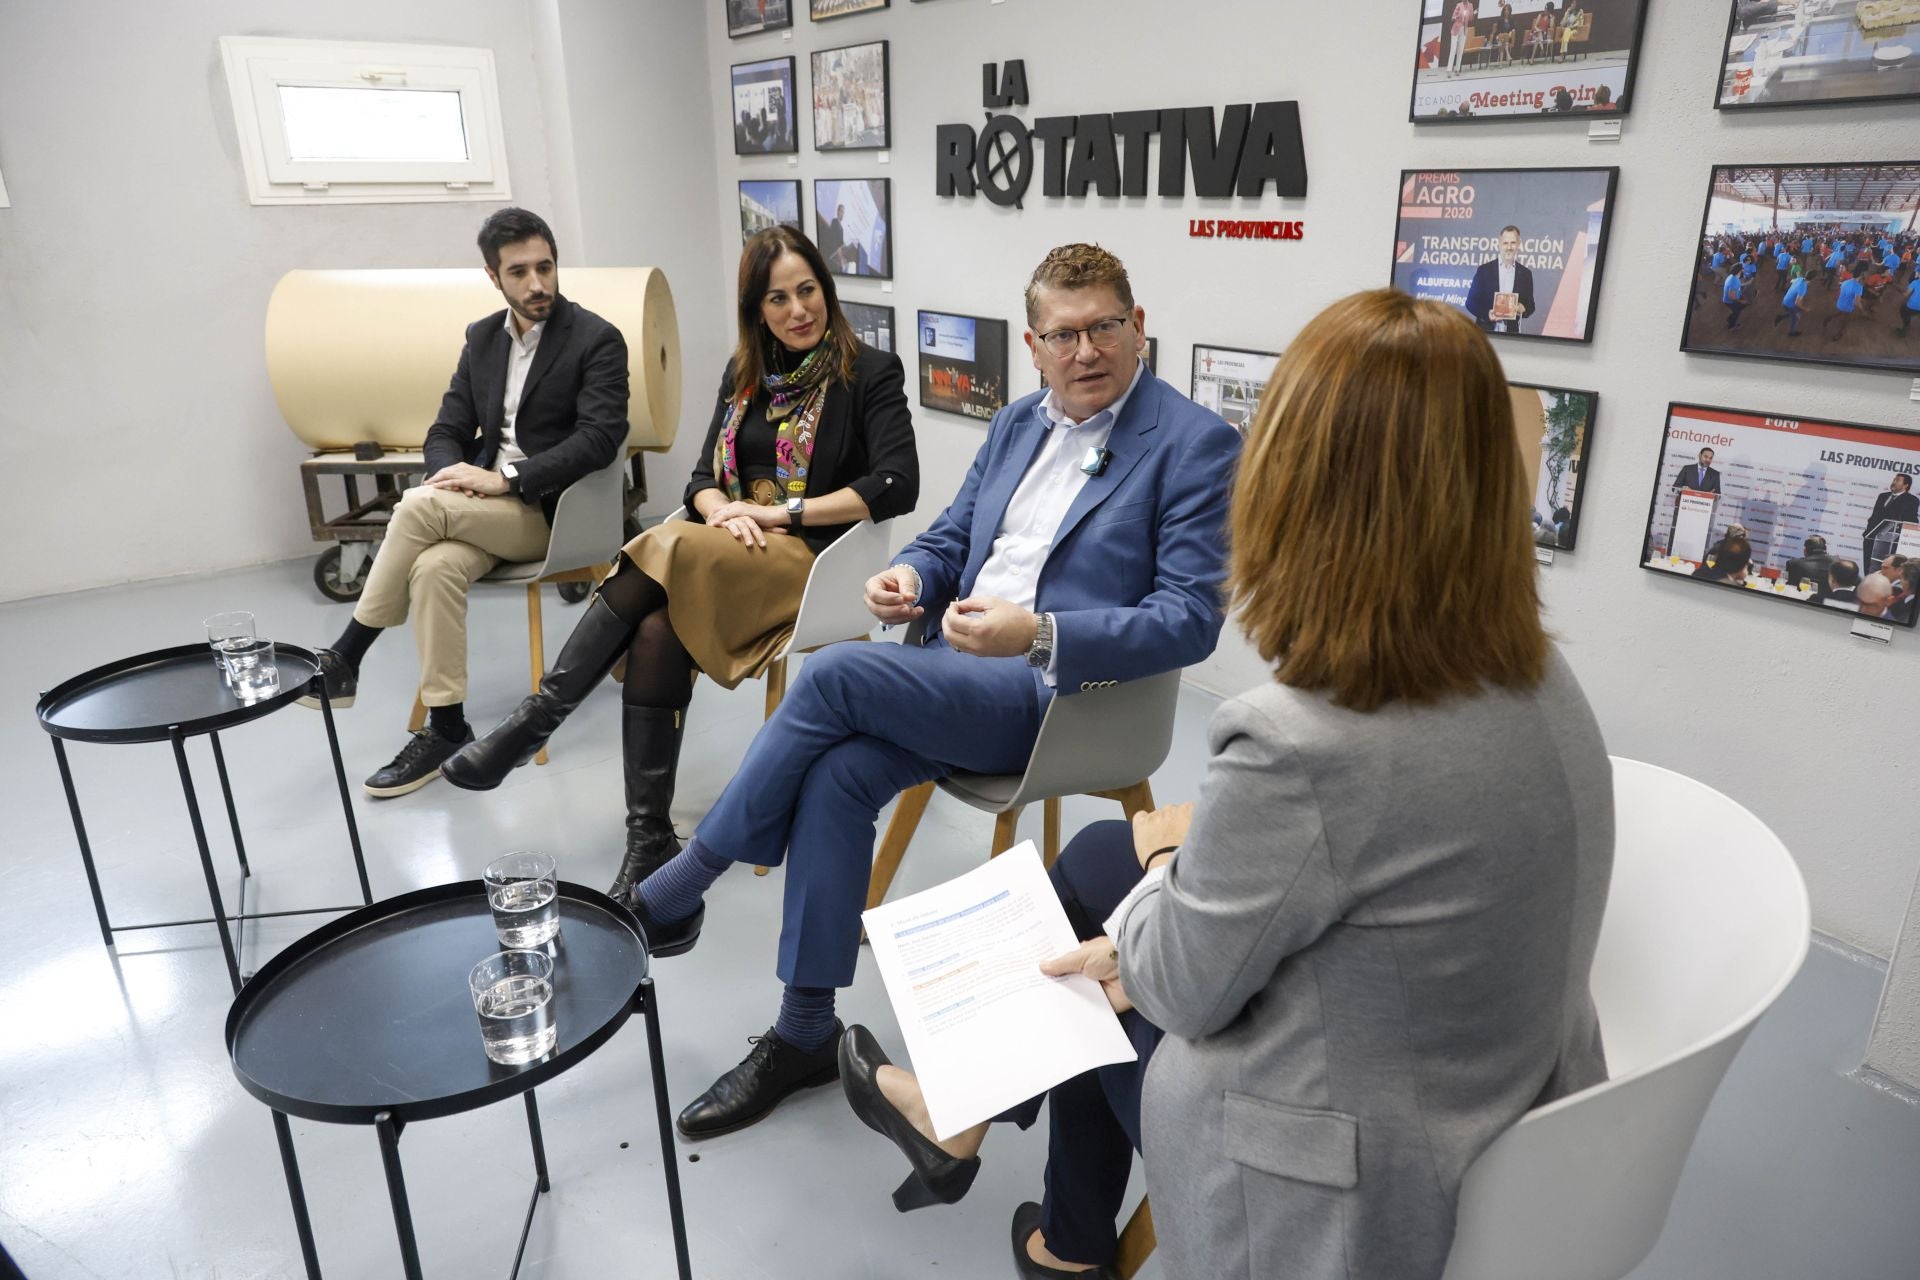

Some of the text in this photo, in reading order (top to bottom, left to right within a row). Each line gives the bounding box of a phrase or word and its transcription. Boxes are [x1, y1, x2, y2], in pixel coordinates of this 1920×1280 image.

[983, 59, 1029, 108] LA
[1470, 89, 1545, 109] Meeting
[936, 100, 1307, 209] ROTATIVA
[1418, 172, 1460, 184] PREMIS
[1416, 186, 1475, 205] AGRO
[1444, 207, 1473, 219] 2020
[1189, 220, 1304, 240] LAS PROVINCIAS
[1422, 235, 1564, 254] TRANSFORACIÓN
[1419, 251, 1564, 270] AGROALIMTARIA
[1417, 277, 1461, 289] ALBUFERA
[1820, 450, 1920, 476] LAS PROVINCIAS
